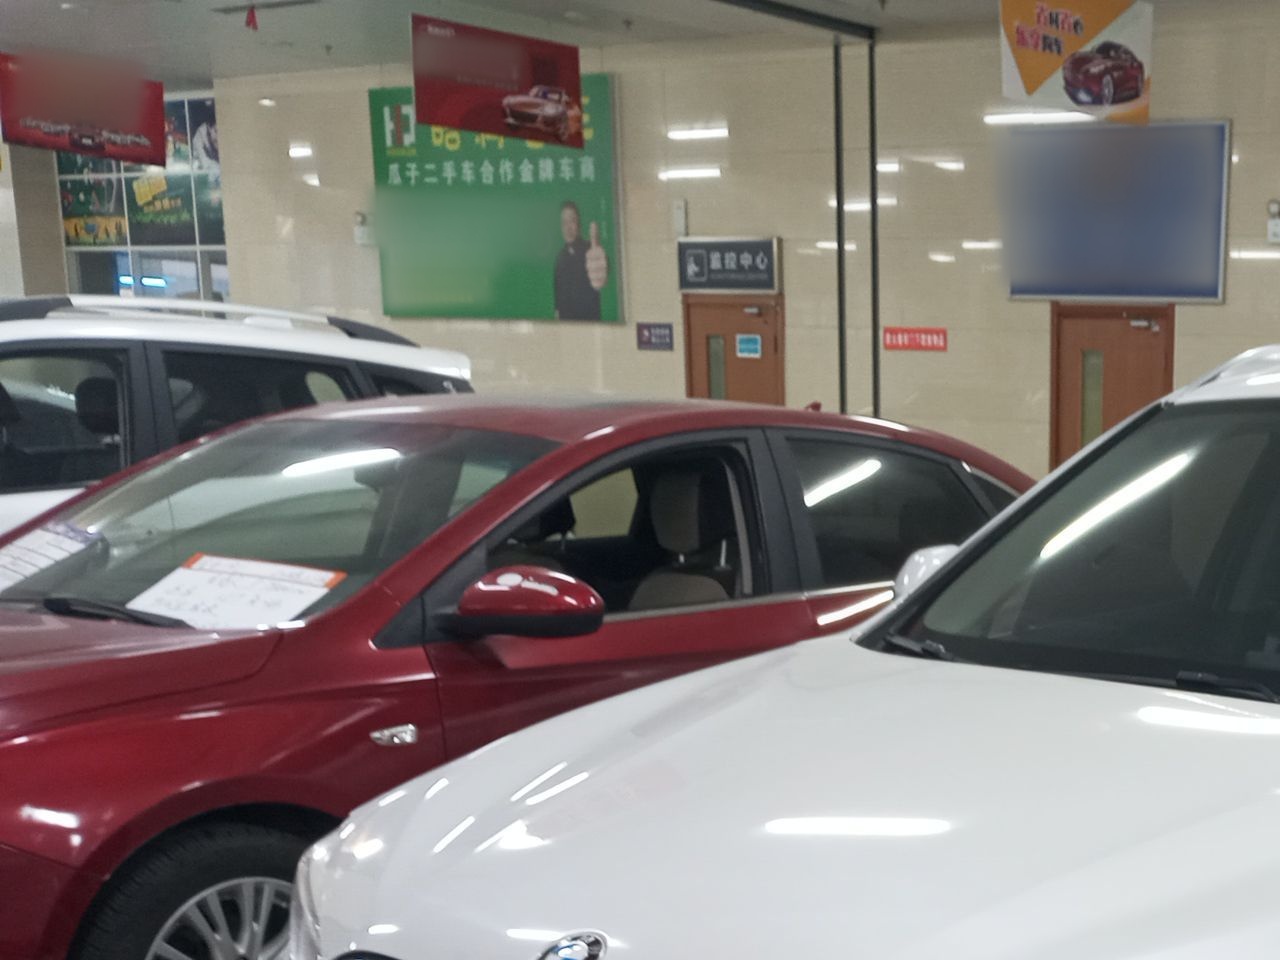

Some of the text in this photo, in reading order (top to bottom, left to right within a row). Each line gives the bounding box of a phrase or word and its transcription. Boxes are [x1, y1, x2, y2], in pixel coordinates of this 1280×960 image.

[388, 156, 595, 186] 瓜子二手车合作金牌车商
[709, 251, 768, 270] 监控中心
